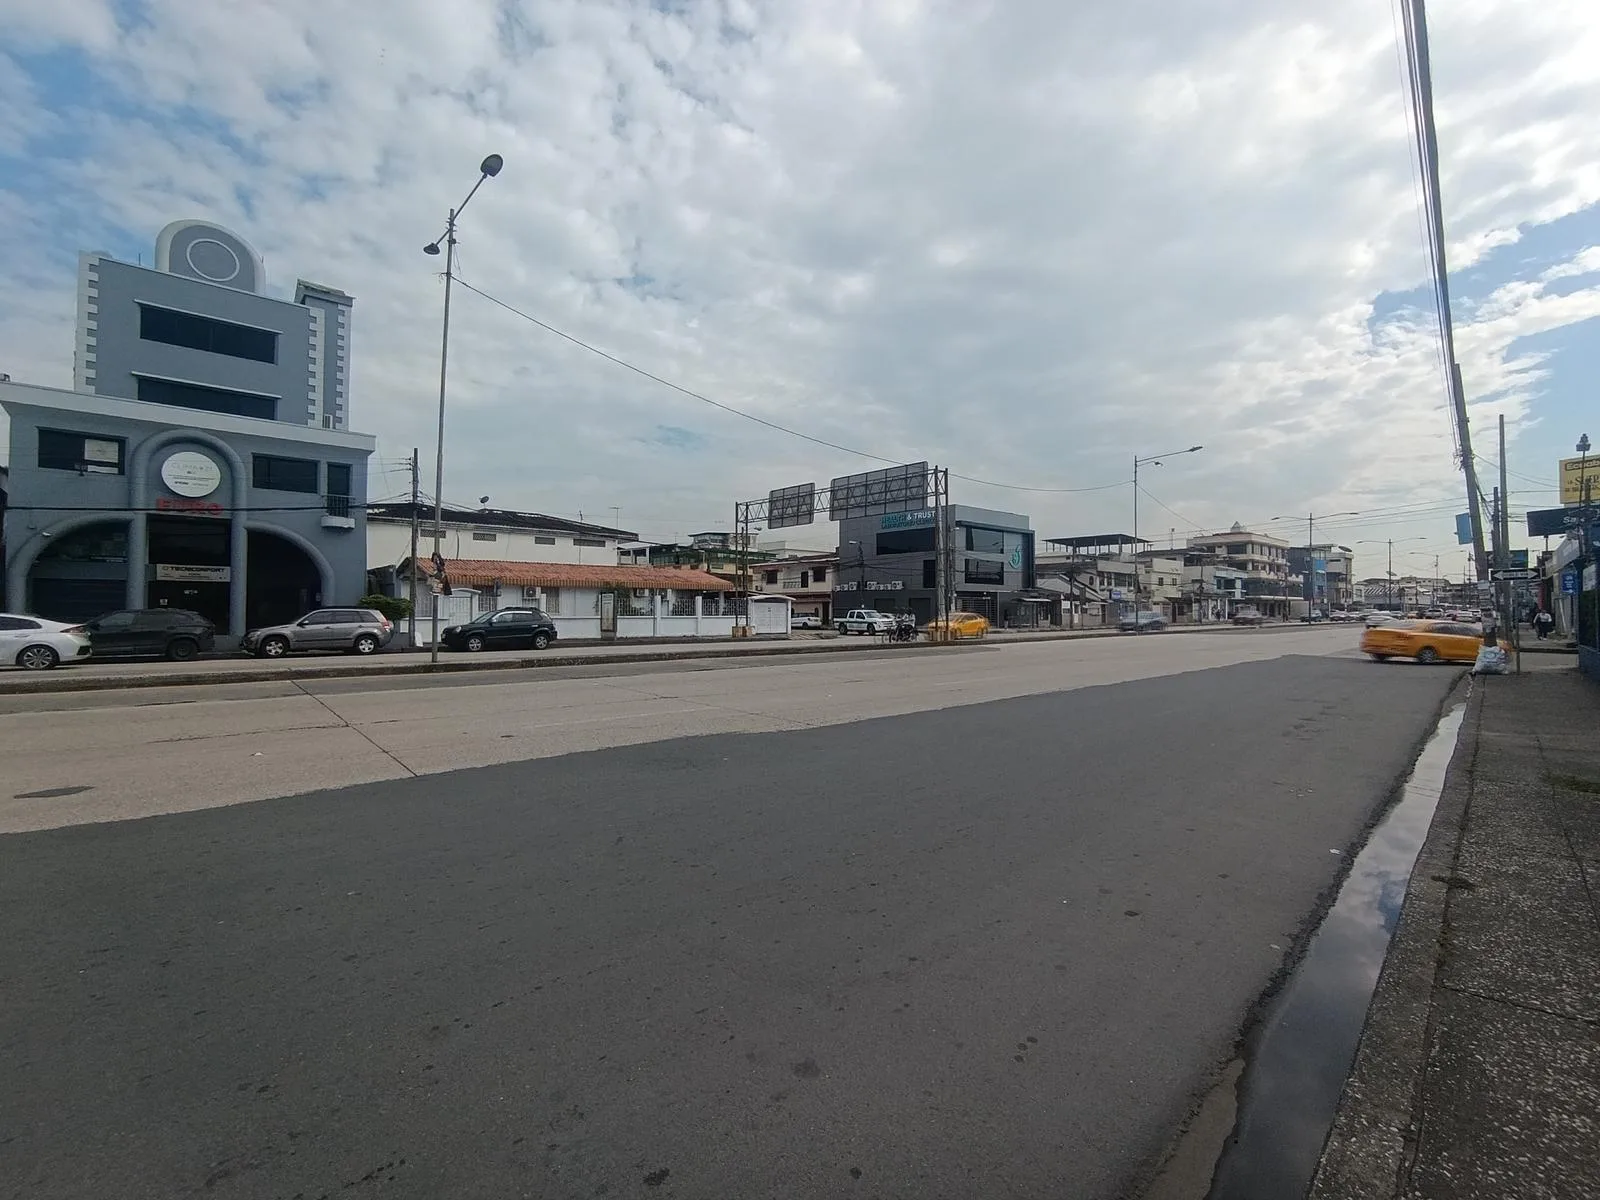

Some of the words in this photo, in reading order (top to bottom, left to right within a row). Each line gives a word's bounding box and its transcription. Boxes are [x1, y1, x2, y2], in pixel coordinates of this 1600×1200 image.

[881, 512, 907, 524] HEALTH
[906, 512, 912, 521] &
[914, 511, 936, 519] TRUST
